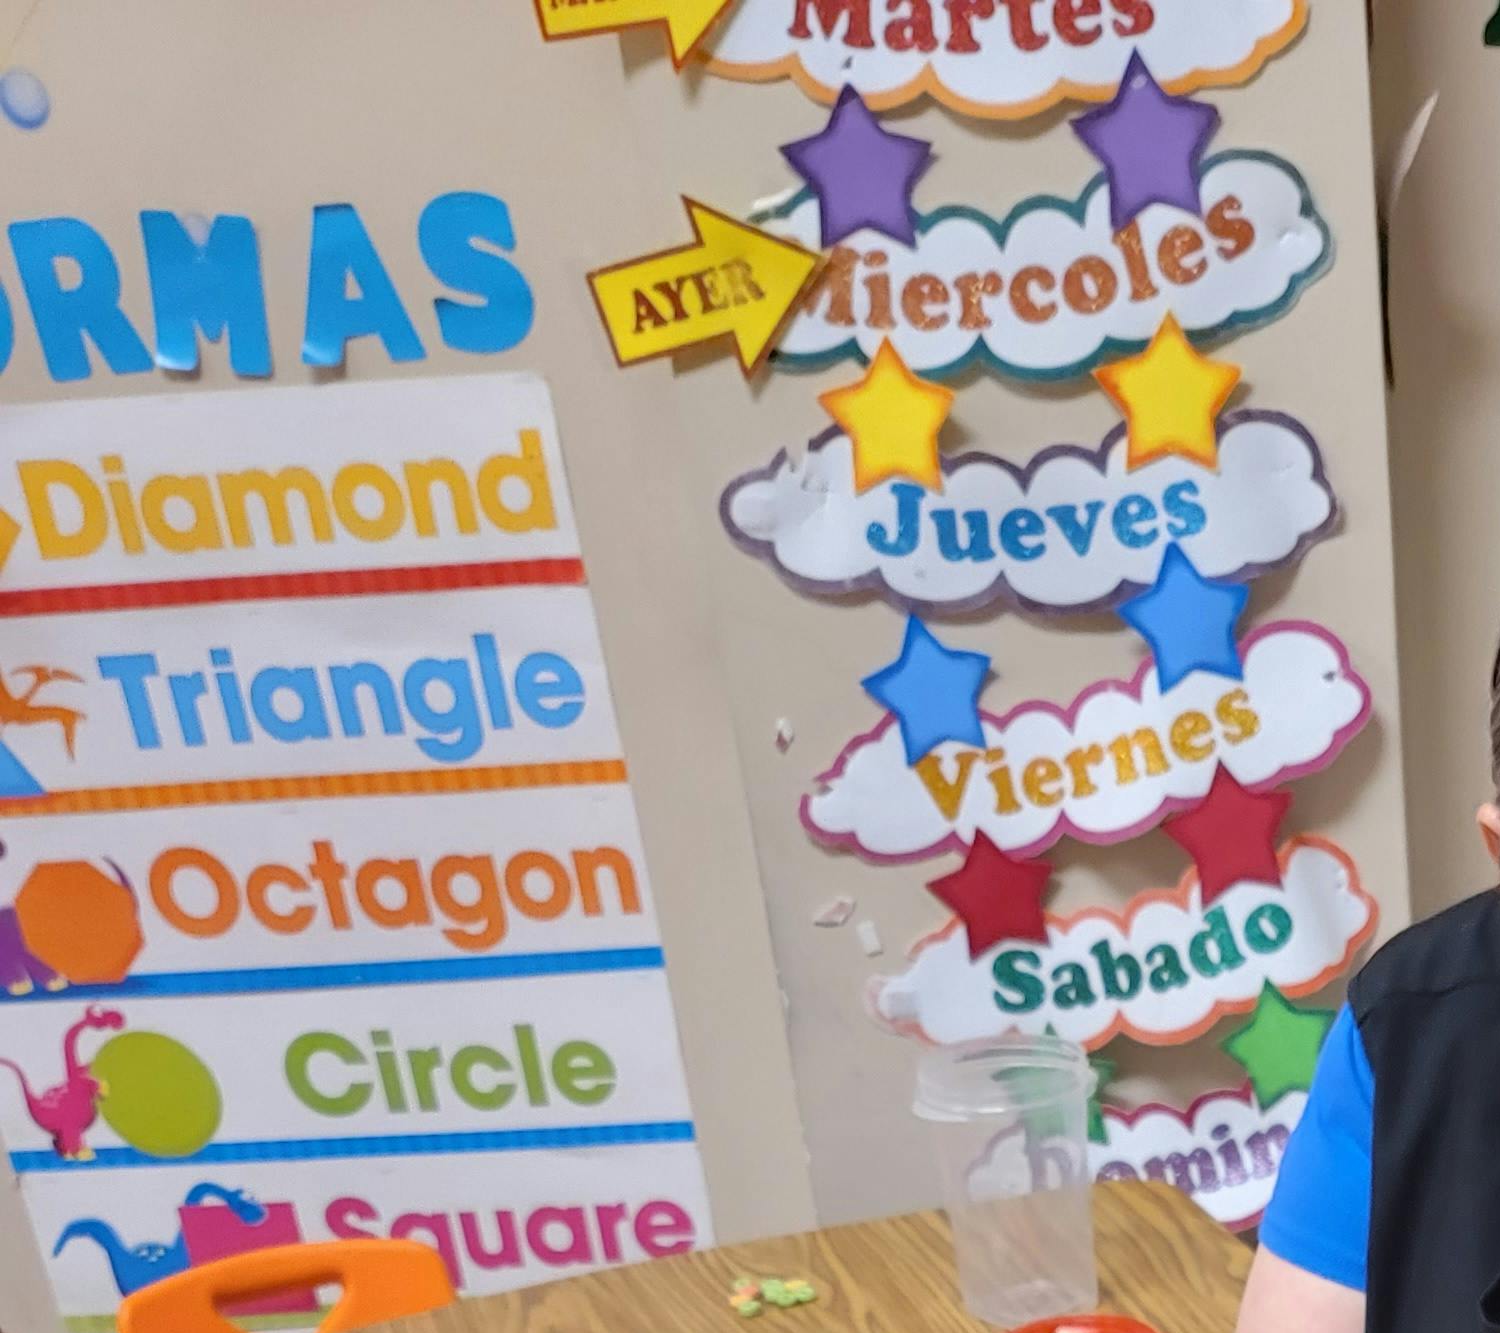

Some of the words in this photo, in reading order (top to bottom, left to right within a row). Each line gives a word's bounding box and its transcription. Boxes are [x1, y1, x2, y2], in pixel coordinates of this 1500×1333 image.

[0, 191, 535, 382] RMAS
[630, 258, 767, 335] AYER
[16, 428, 558, 560] Diamond
[867, 478, 1208, 564] Jueves
[95, 633, 587, 762] Triangle
[915, 687, 1262, 822] Viernes
[149, 840, 643, 951] Octagon
[992, 901, 1295, 1014] Sabado
[284, 1024, 617, 1118] Circle
